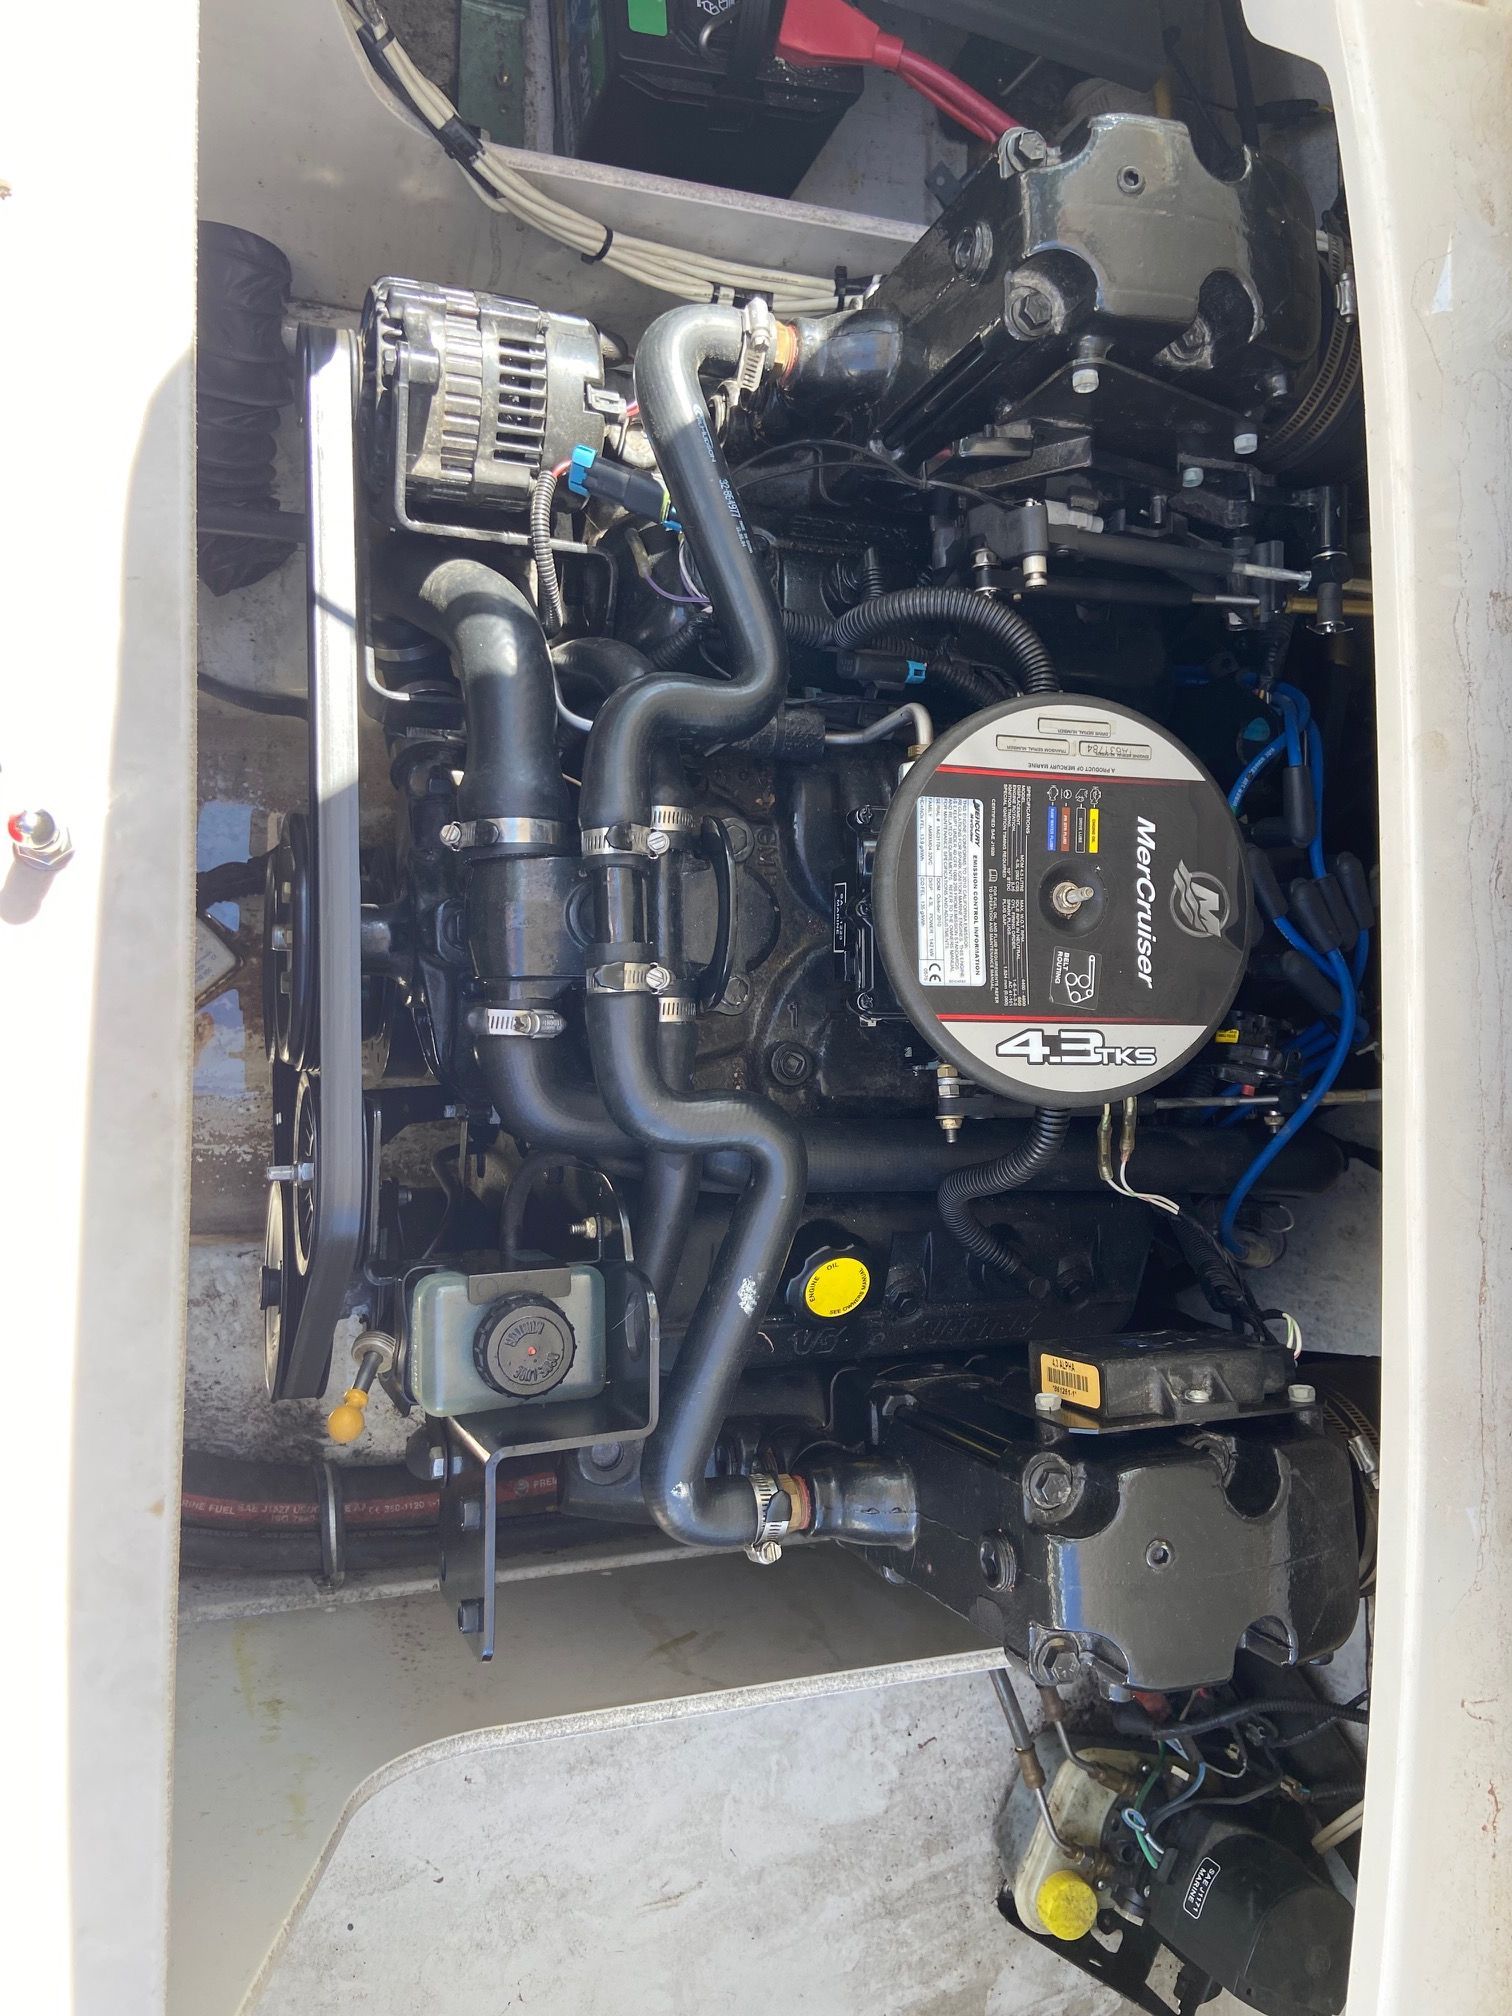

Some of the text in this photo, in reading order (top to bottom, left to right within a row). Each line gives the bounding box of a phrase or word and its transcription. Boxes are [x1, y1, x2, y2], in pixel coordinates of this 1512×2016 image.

[963, 867, 967, 875] TO
[1136, 816, 1156, 989] MerCruiser
[1055, 951, 1063, 984] ROUTING
[809, 1262, 839, 1303] ENGINE OIL
[843, 1292, 864, 1311] OWNERS
[859, 1268, 867, 1290] MANUAL
[1060, 1359, 1075, 1372] ALPHA
[208, 1505, 235, 1514] FUEL
[1188, 1868, 1206, 1903] MARINE
[1193, 1868, 1215, 1912] SAE J1171
